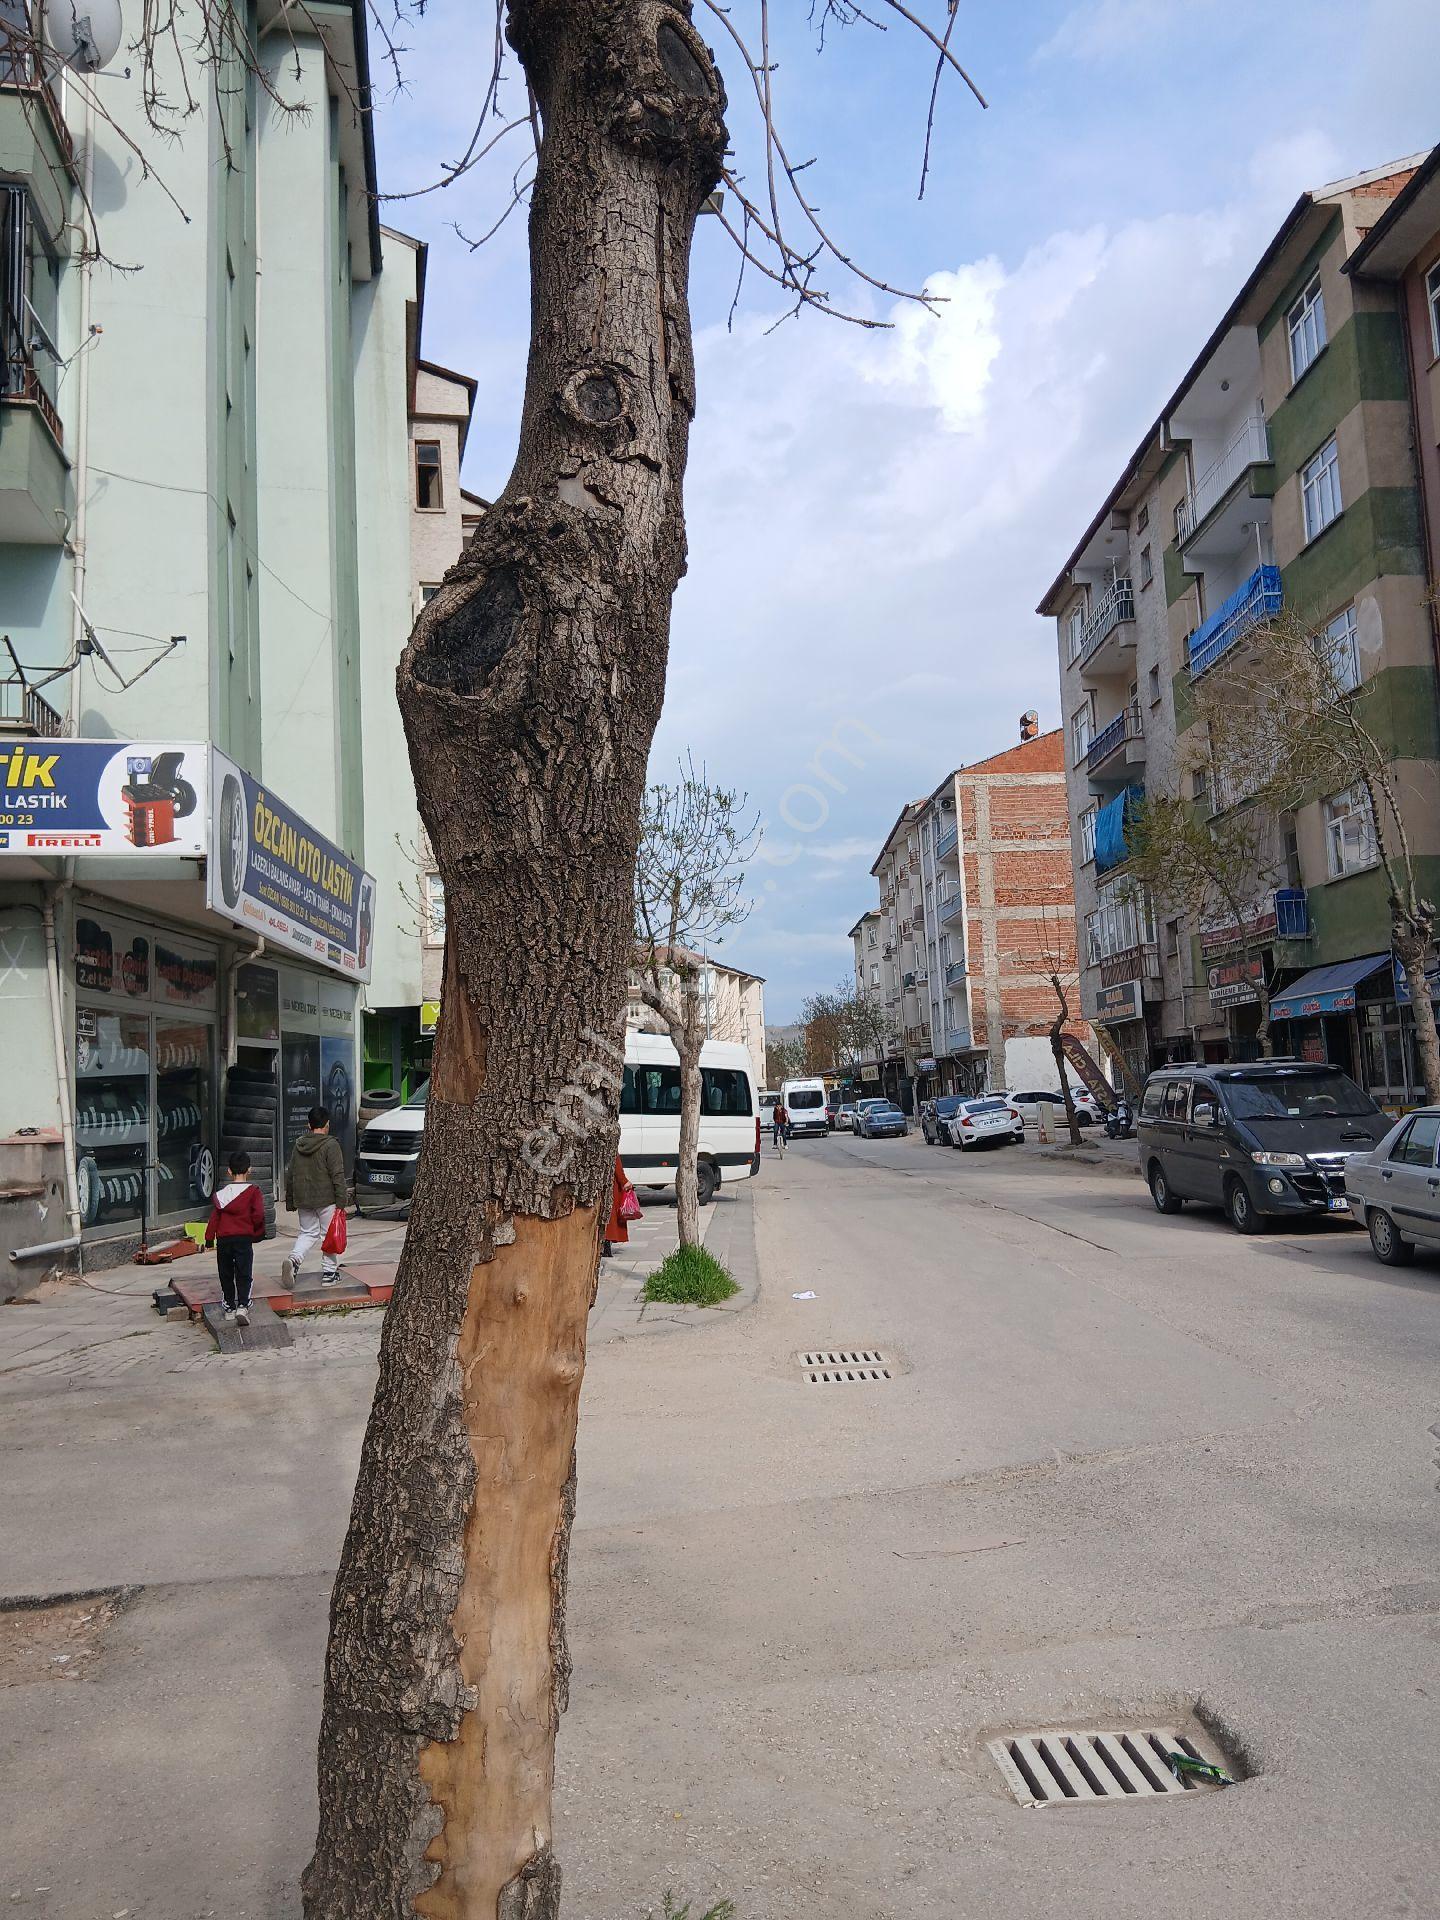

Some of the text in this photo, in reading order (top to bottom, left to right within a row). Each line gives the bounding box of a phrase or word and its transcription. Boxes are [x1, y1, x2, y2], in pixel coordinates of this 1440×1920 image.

[5, 792, 67, 809] LASTİK
[17, 814, 33, 825] 23
[28, 834, 101, 847] PIRELLI
[254, 791, 297, 867] ÖZCAN
[298, 836, 321, 884] OTO
[321, 854, 354, 907] LASTİK
